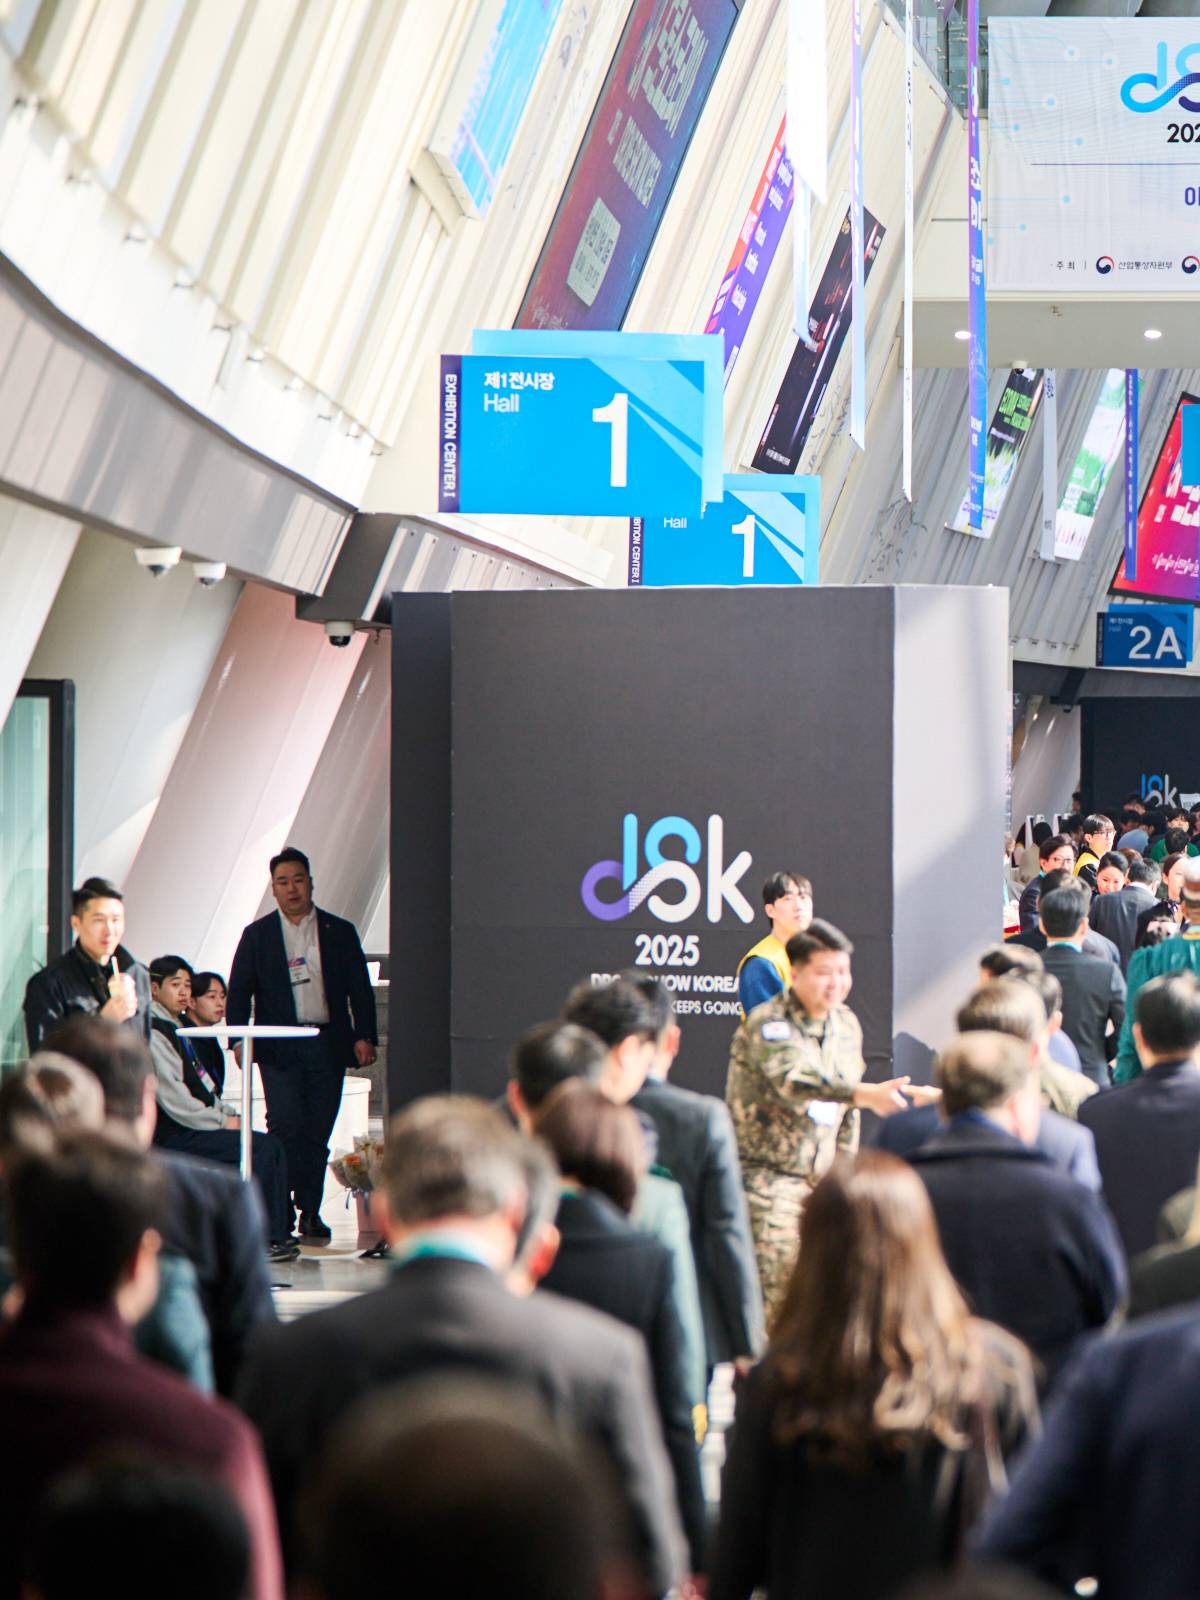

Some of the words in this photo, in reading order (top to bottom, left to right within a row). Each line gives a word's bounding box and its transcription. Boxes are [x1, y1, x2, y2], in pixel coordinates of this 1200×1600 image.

[483, 371, 555, 391] 제1전시장
[444, 374, 457, 440] EXHIBITION
[483, 394, 520, 413] Hall
[592, 392, 629, 488] 1
[443, 441, 456, 488] CENTER
[663, 517, 688, 529] Hall
[631, 546, 641, 578] CENTER
[731, 514, 756, 578] 1
[1128, 625, 1183, 660] 2A
[634, 933, 700, 967] 2025
